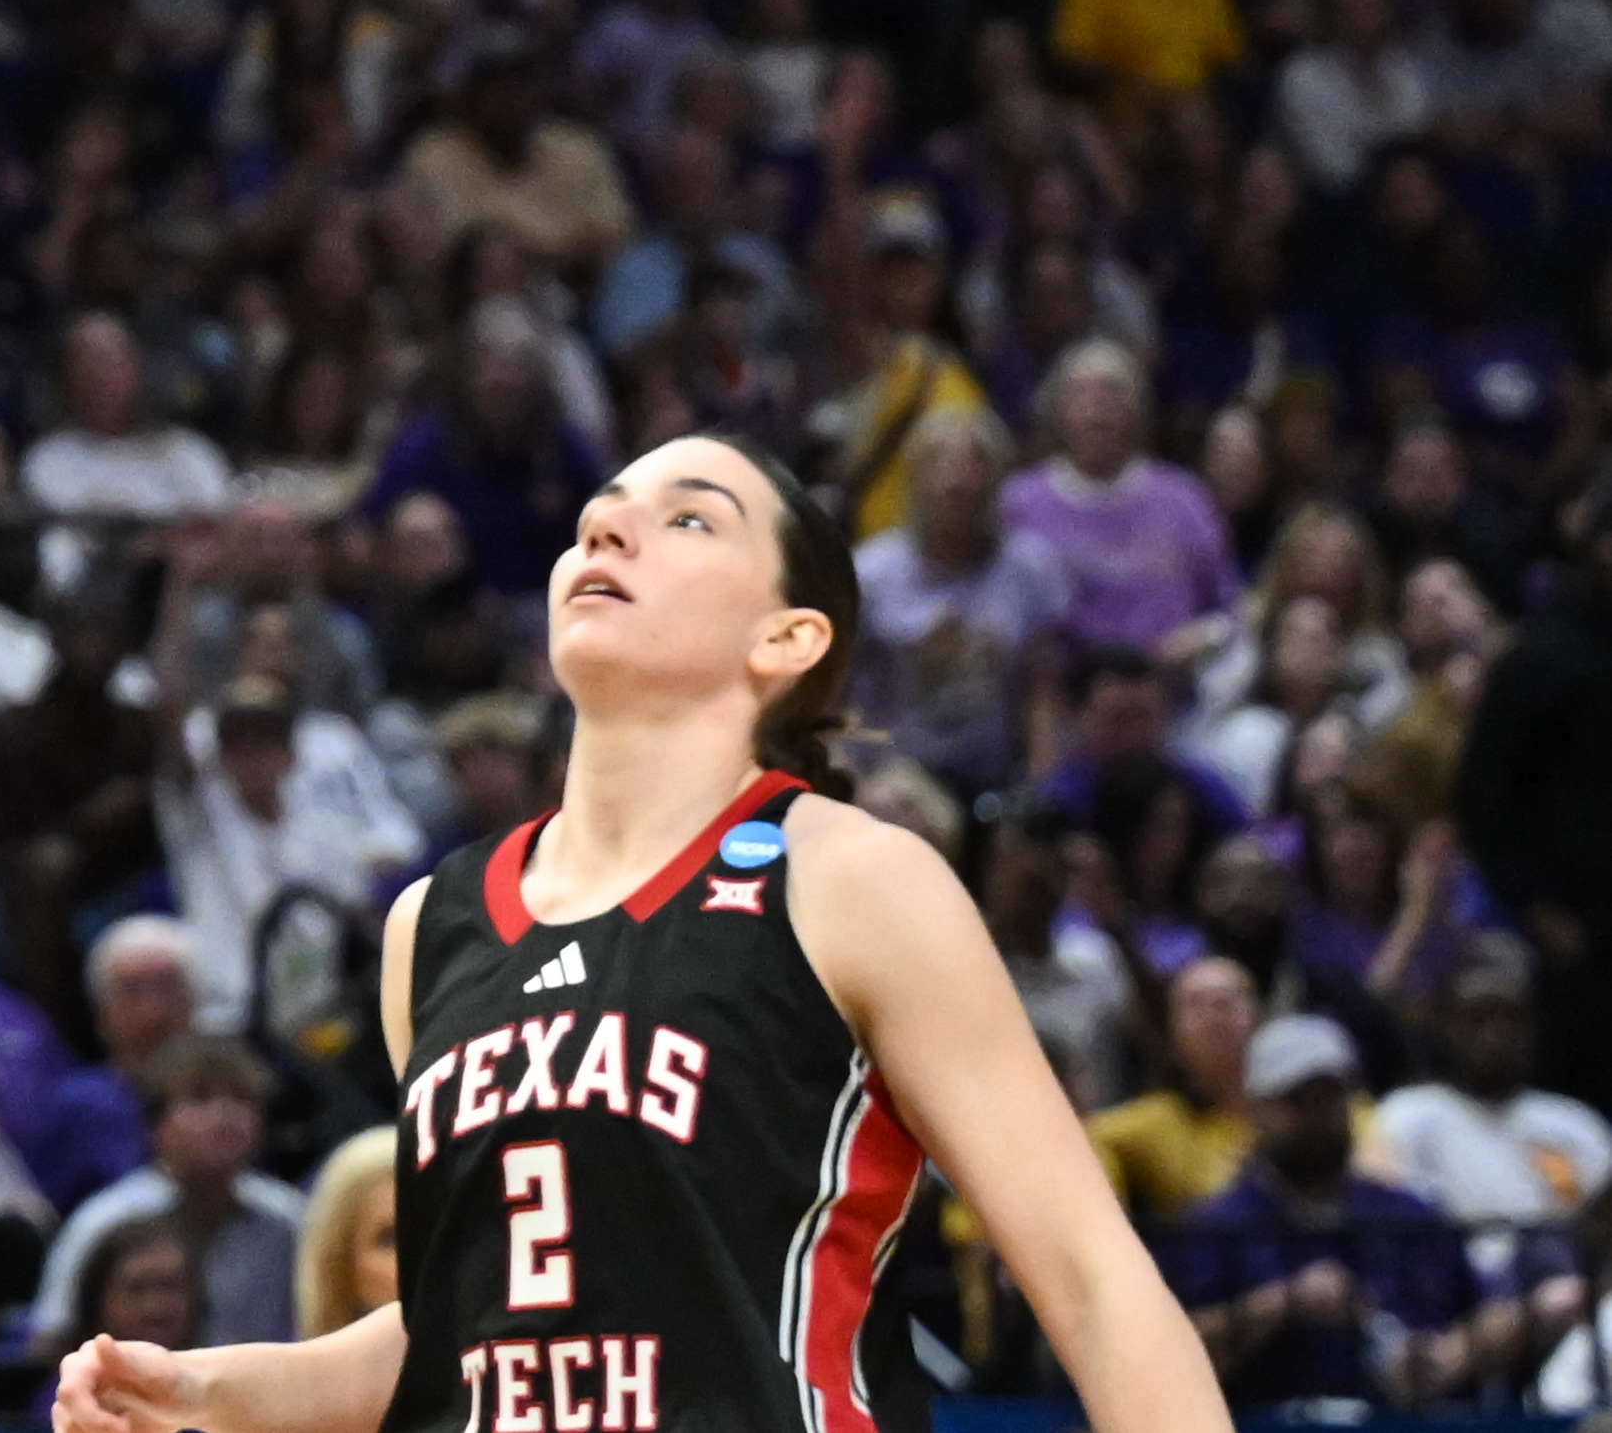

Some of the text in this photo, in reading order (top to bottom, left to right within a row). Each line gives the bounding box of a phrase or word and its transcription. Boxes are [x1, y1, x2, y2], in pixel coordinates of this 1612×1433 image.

[404, 1010, 708, 1171] TEXAS
[501, 1139, 575, 1311] 2
[460, 1334, 661, 1433] TECH
